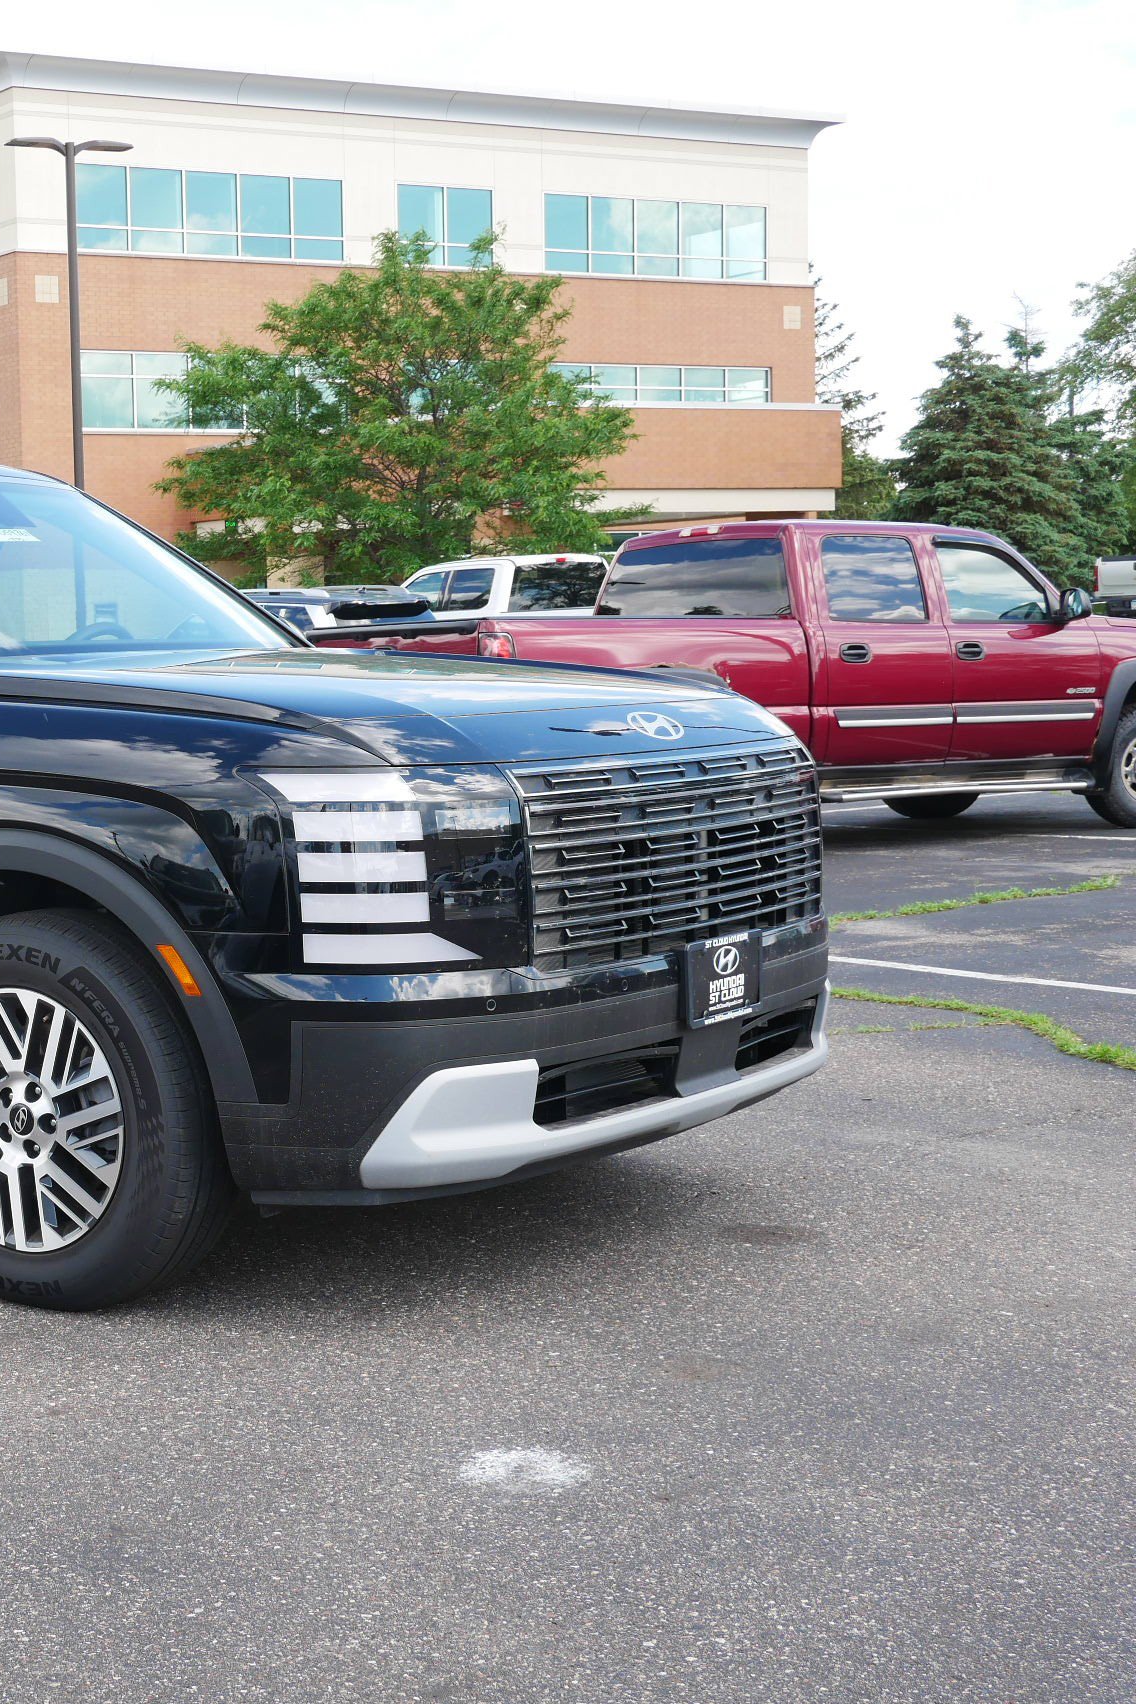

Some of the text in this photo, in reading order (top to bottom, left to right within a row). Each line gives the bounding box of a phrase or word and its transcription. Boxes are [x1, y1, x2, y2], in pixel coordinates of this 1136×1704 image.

[705, 940, 712, 948] ST
[713, 937, 728, 947] CLOUD
[709, 974, 745, 993] HYUNDAI
[709, 986, 745, 1004] ST CLOUD
